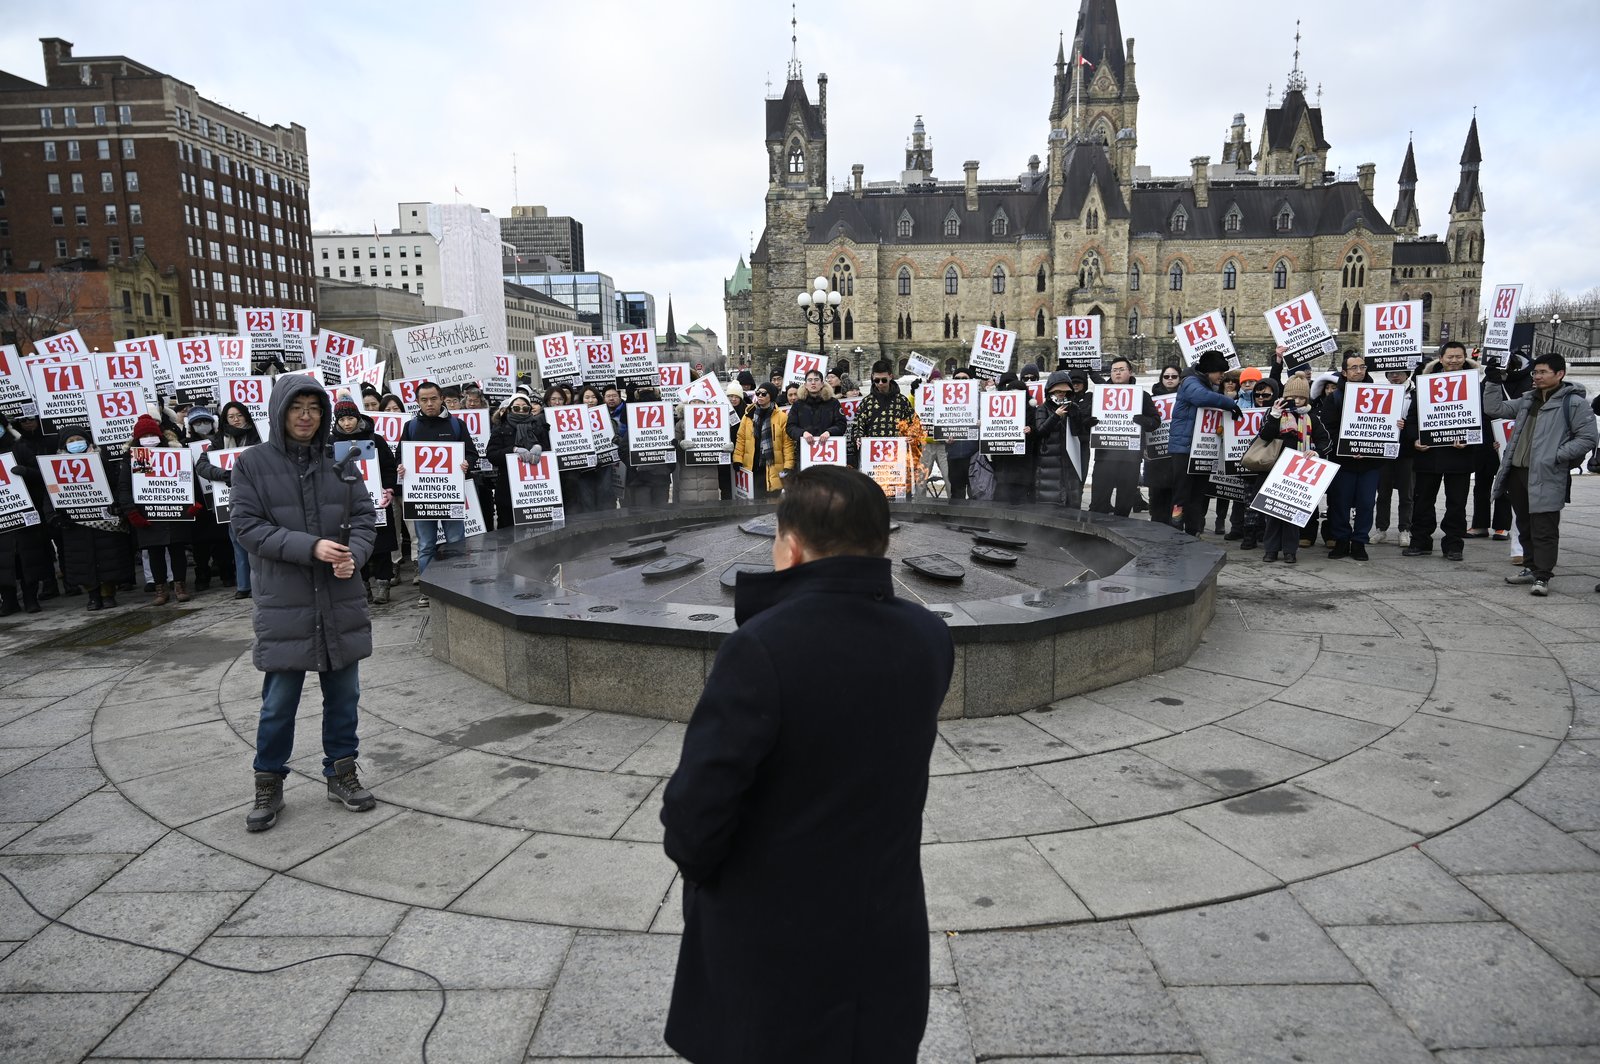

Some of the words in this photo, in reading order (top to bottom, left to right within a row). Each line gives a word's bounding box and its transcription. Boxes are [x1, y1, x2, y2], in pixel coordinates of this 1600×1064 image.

[1497, 290, 1514, 317] 33
[251, 312, 272, 330] 25
[283, 313, 299, 331] 31
[1280, 303, 1305, 329] 37
[1379, 306, 1408, 330] 40
[408, 327, 435, 342] ASSEZ
[1068, 320, 1089, 338] 19
[1189, 319, 1213, 344] 13
[1284, 332, 1307, 346] WAITING
[1308, 327, 1320, 335] FOR
[1288, 324, 1312, 337] MONTHS
[1296, 331, 1326, 346] RESPONSE
[51, 336, 76, 354] 36
[220, 340, 239, 359] 19
[330, 335, 350, 357] 31
[411, 327, 488, 353] INTERMINABLE
[546, 337, 565, 356] 63
[623, 334, 645, 354] 34
[983, 332, 1004, 352] 43
[1195, 340, 1217, 352] MONTHS
[183, 341, 208, 363] 53
[406, 356, 420, 364] Nos
[591, 344, 612, 363] 38
[112, 357, 138, 378] 15
[348, 356, 362, 377] 34
[796, 356, 816, 373] 27
[48, 366, 79, 391] 71
[661, 368, 679, 384] 37
[233, 381, 259, 402] 68
[945, 384, 969, 403] 33
[1105, 389, 1129, 410] 30
[1434, 377, 1462, 402] 37
[103, 392, 131, 416] 53
[992, 396, 1014, 417] 90
[1360, 389, 1387, 413] 37
[558, 410, 580, 431] 33
[640, 407, 661, 427] 72
[696, 408, 718, 428] 23
[1204, 410, 1218, 433] 31
[1238, 413, 1261, 435] 20
[1439, 418, 1476, 426] RESPONSE
[376, 416, 399, 441] 40
[419, 447, 448, 473] 22
[812, 441, 834, 461] 25
[873, 441, 897, 461] 33
[59, 460, 89, 483] 42
[151, 452, 177, 476] 40
[1289, 459, 1317, 484] 14
[1272, 482, 1298, 496] WAITING
[1299, 491, 1312, 501] FOR
[1281, 479, 1308, 492] MONTHS
[1264, 488, 1280, 498] IRCC
[1280, 492, 1311, 508] RESPONSE
